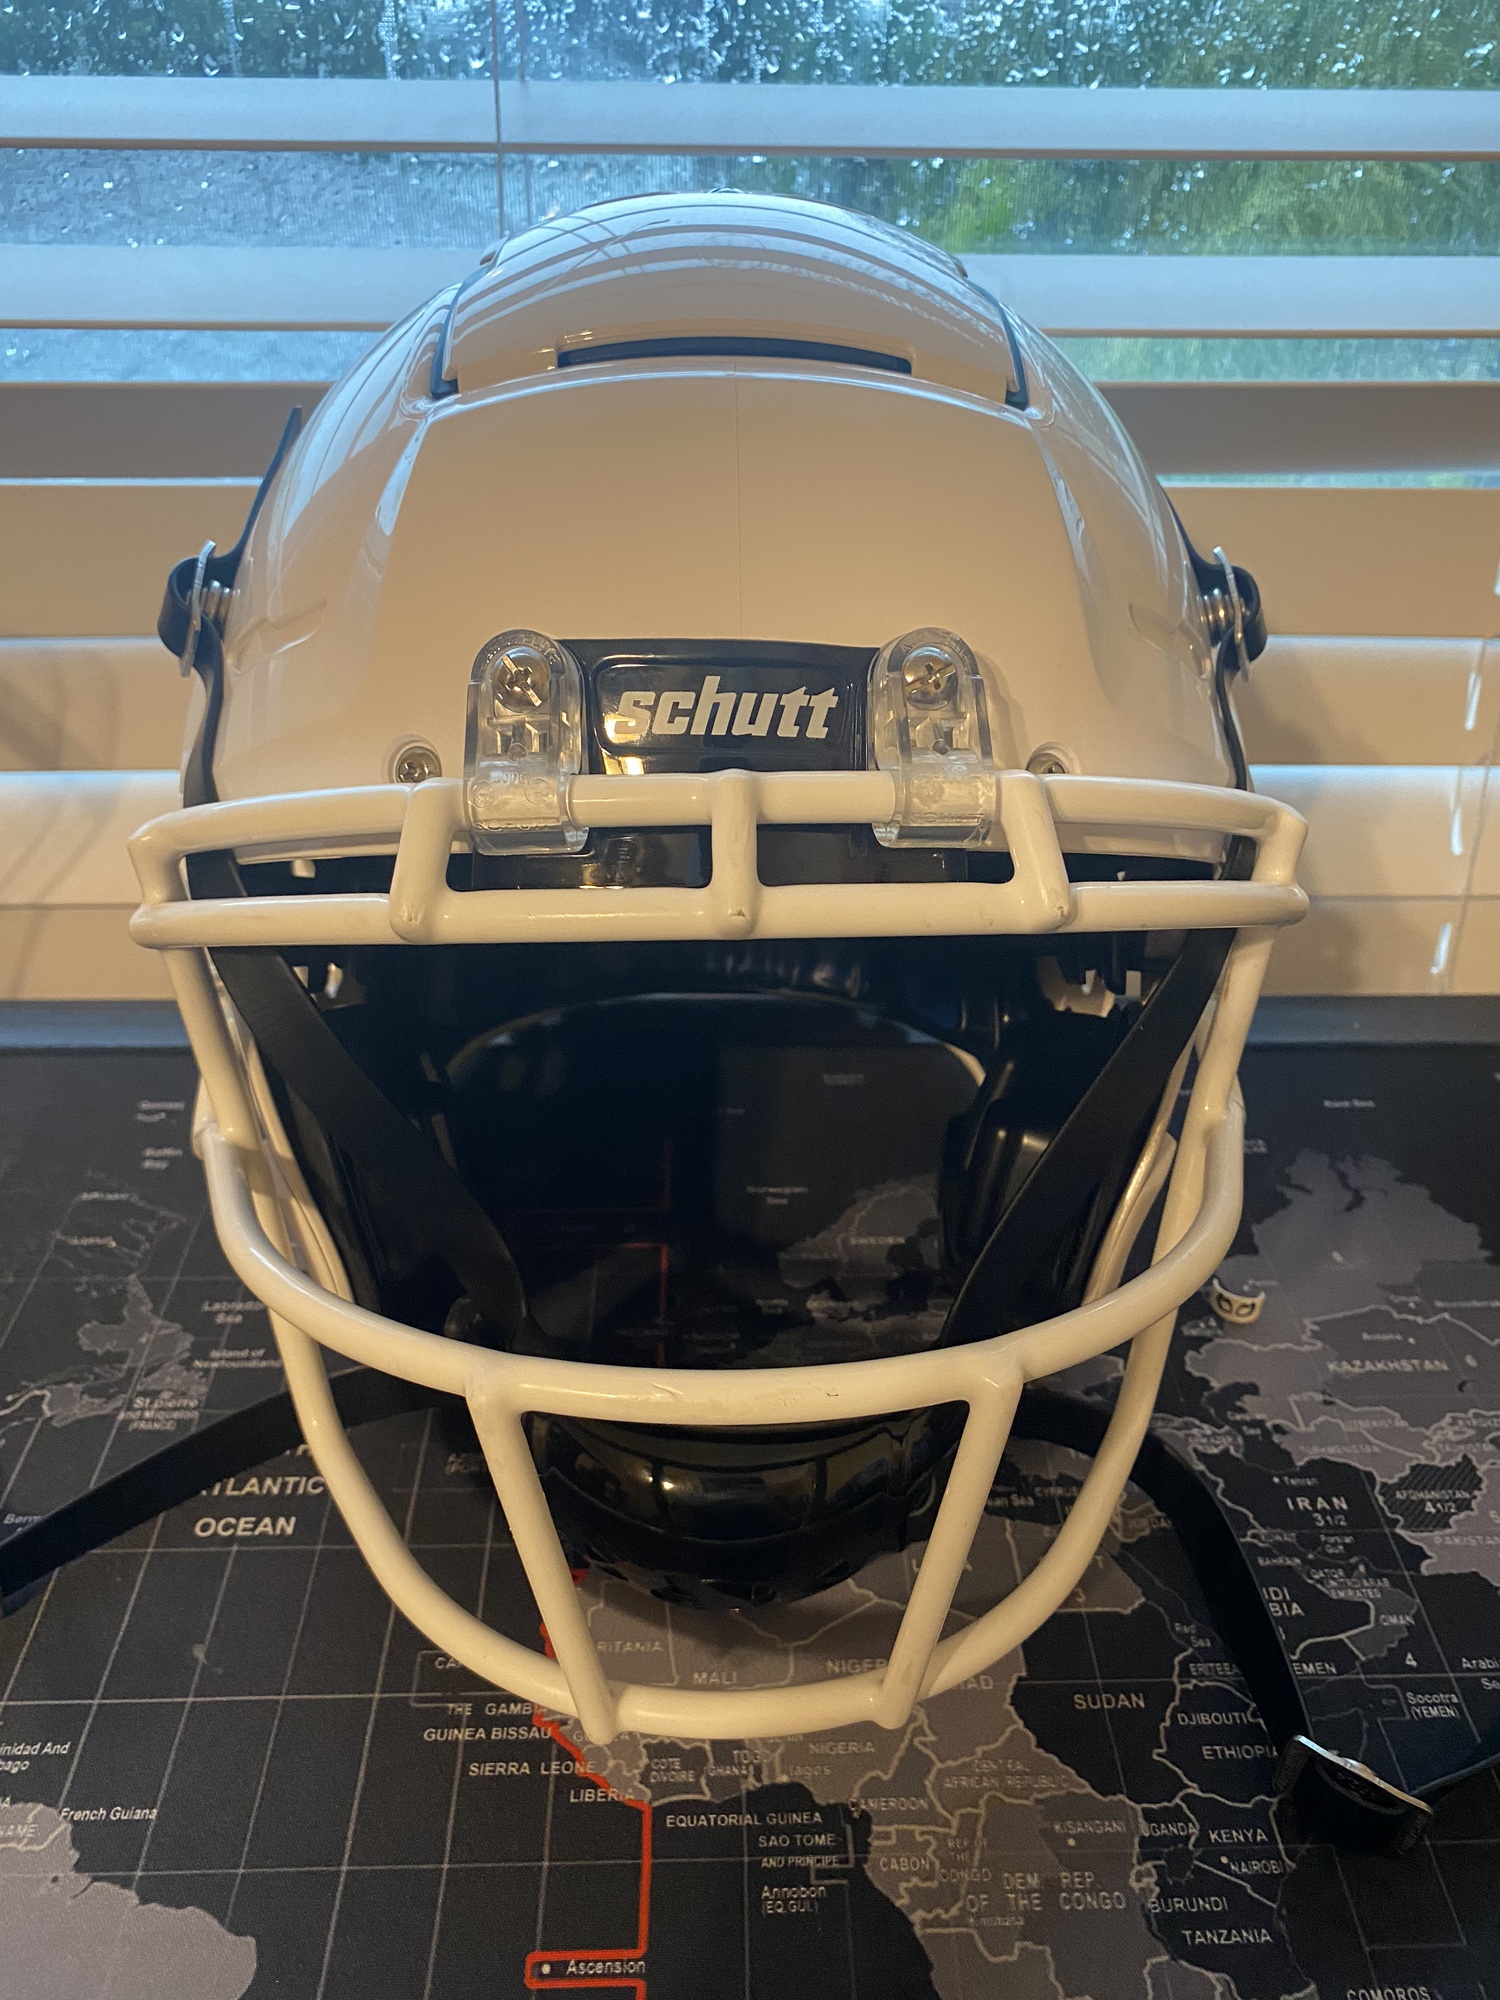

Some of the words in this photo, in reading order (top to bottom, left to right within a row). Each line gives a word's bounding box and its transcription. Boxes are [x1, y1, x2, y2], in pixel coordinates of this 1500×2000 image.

[614, 675, 839, 739] schutt
[1286, 1496, 1349, 1511] IRAN
[193, 1515, 297, 1538] OCEAN
[1404, 1652, 1418, 1668] 4
[692, 1670, 738, 1685] MALI
[1073, 1693, 1146, 1709] SUDAN
[1405, 1691, 1459, 1705] Socotra
[447, 1702, 473, 1716] THE
[1177, 1711, 1248, 1726] DJIBOUTI
[423, 1727, 486, 1742] GUINEA
[490, 1725, 552, 1740] BISSAU
[42, 1741, 71, 1756] And
[809, 1740, 876, 1755] NIGERIA
[469, 1761, 531, 1776] SIERRA
[540, 1760, 596, 1775] LEONE
[59, 1807, 106, 1821] French
[109, 1806, 157, 1821] Guiana
[665, 1813, 761, 1828] EQUATORIAL
[766, 1811, 823, 1826] GUINEA
[758, 1834, 790, 1848] SAO
[793, 1832, 837, 1847] TOME
[1209, 1828, 1269, 1844] KENYA
[761, 1855, 785, 1868] AND
[1229, 1859, 1285, 1875] NAIROBI
[965, 1893, 989, 1912] OF
[1060, 1891, 1127, 1910] CONGO
[1150, 1896, 1229, 1913] BURUNDI
[1182, 1928, 1274, 1945] TANZANIA
[565, 1958, 646, 1975] Ascension
